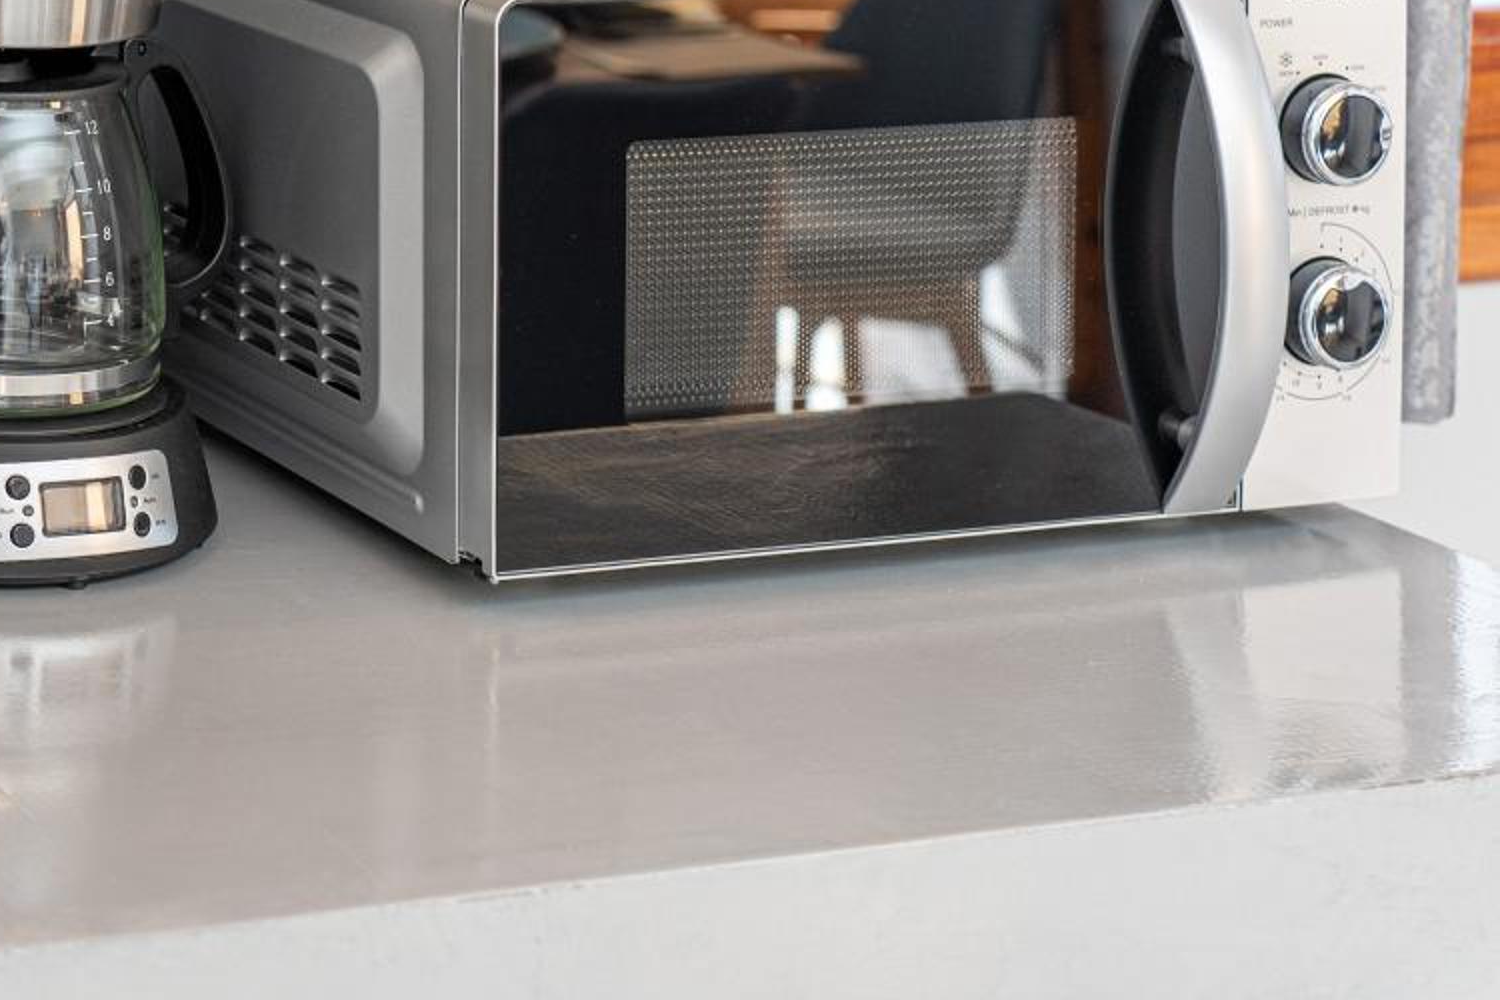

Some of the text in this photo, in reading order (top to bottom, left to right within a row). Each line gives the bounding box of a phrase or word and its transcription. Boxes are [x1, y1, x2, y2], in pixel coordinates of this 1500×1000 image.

[1259, 17, 1293, 29] POWER
[84, 120, 99, 135] 12
[96, 180, 112, 195] 10
[102, 225, 112, 242] 8
[105, 271, 115, 287] 6
